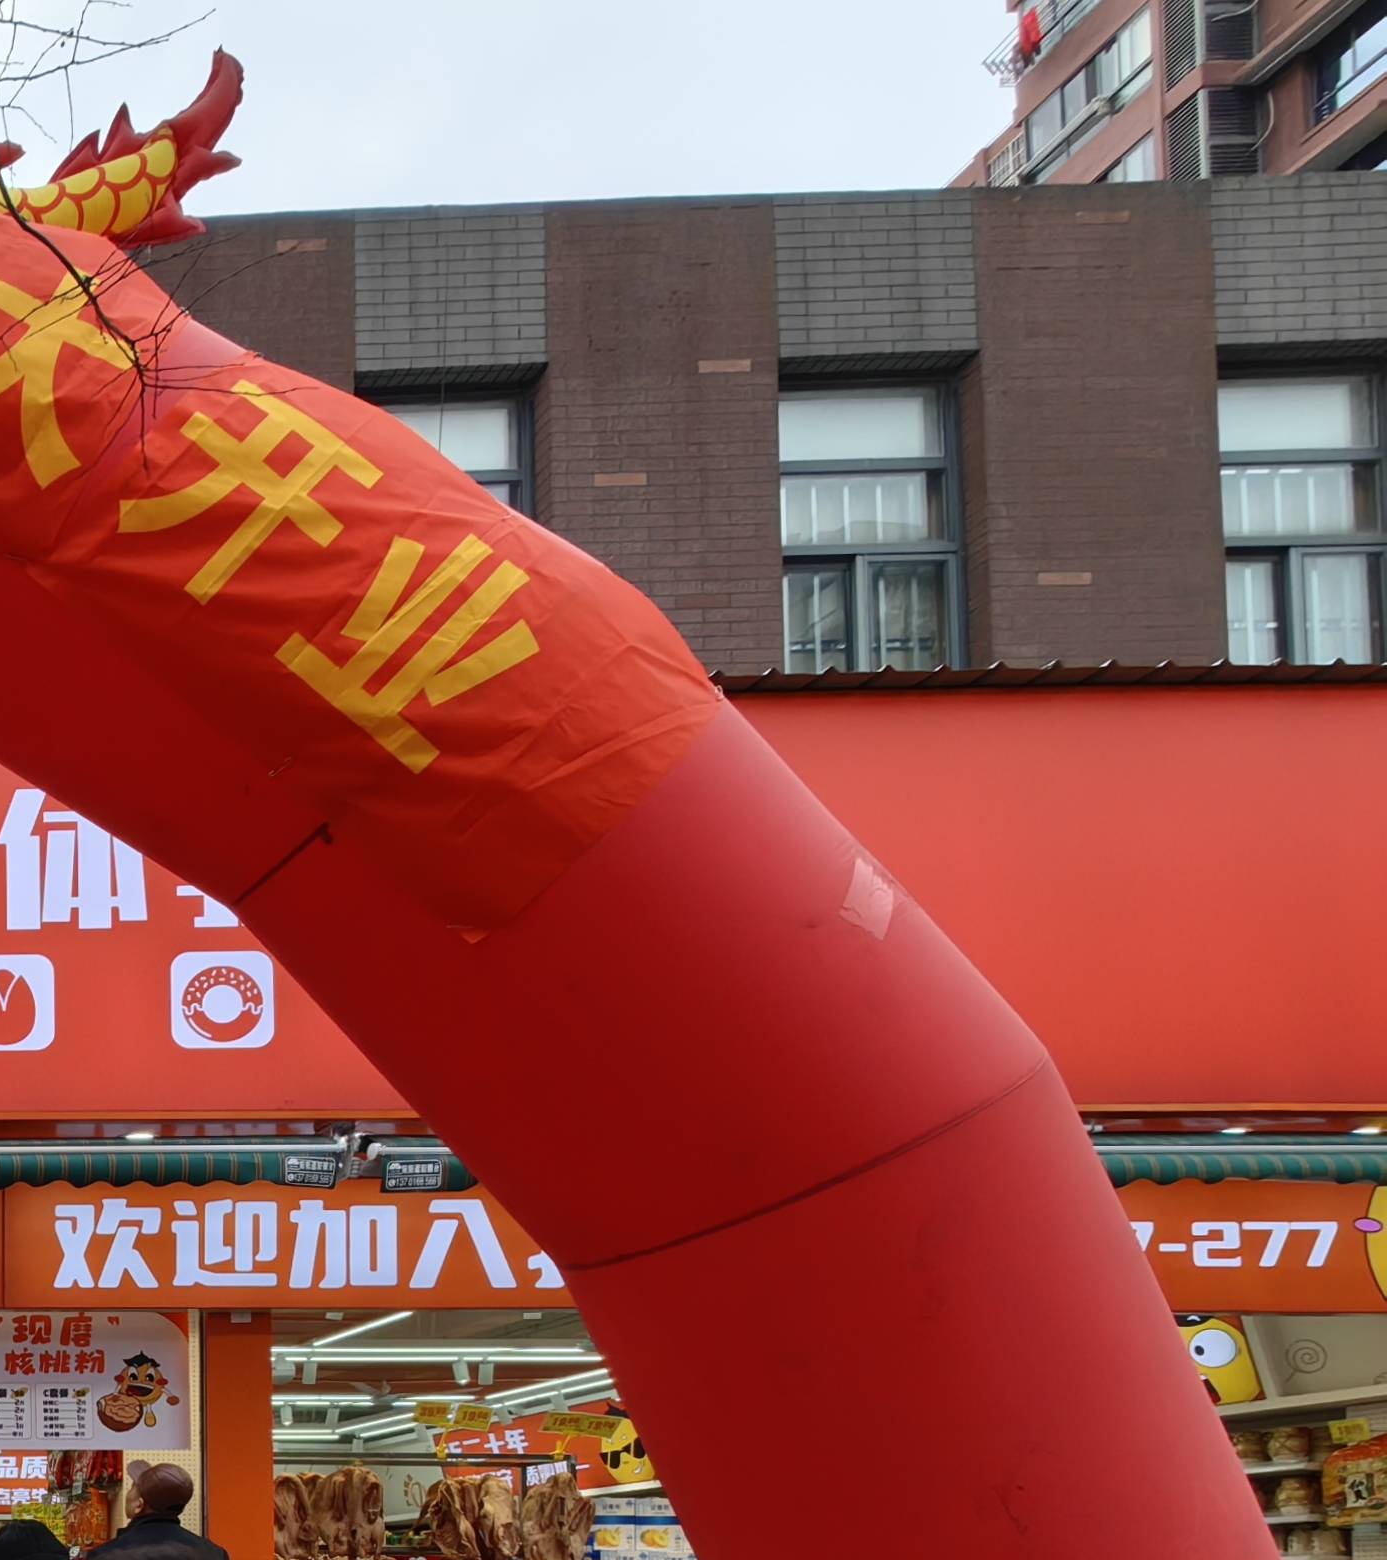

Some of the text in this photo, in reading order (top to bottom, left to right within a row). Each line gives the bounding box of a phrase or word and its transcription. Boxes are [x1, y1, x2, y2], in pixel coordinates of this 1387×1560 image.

[53, 1198, 564, 1290] 欢迎加入
[4, 1348, 106, 1376] 核桃粉
